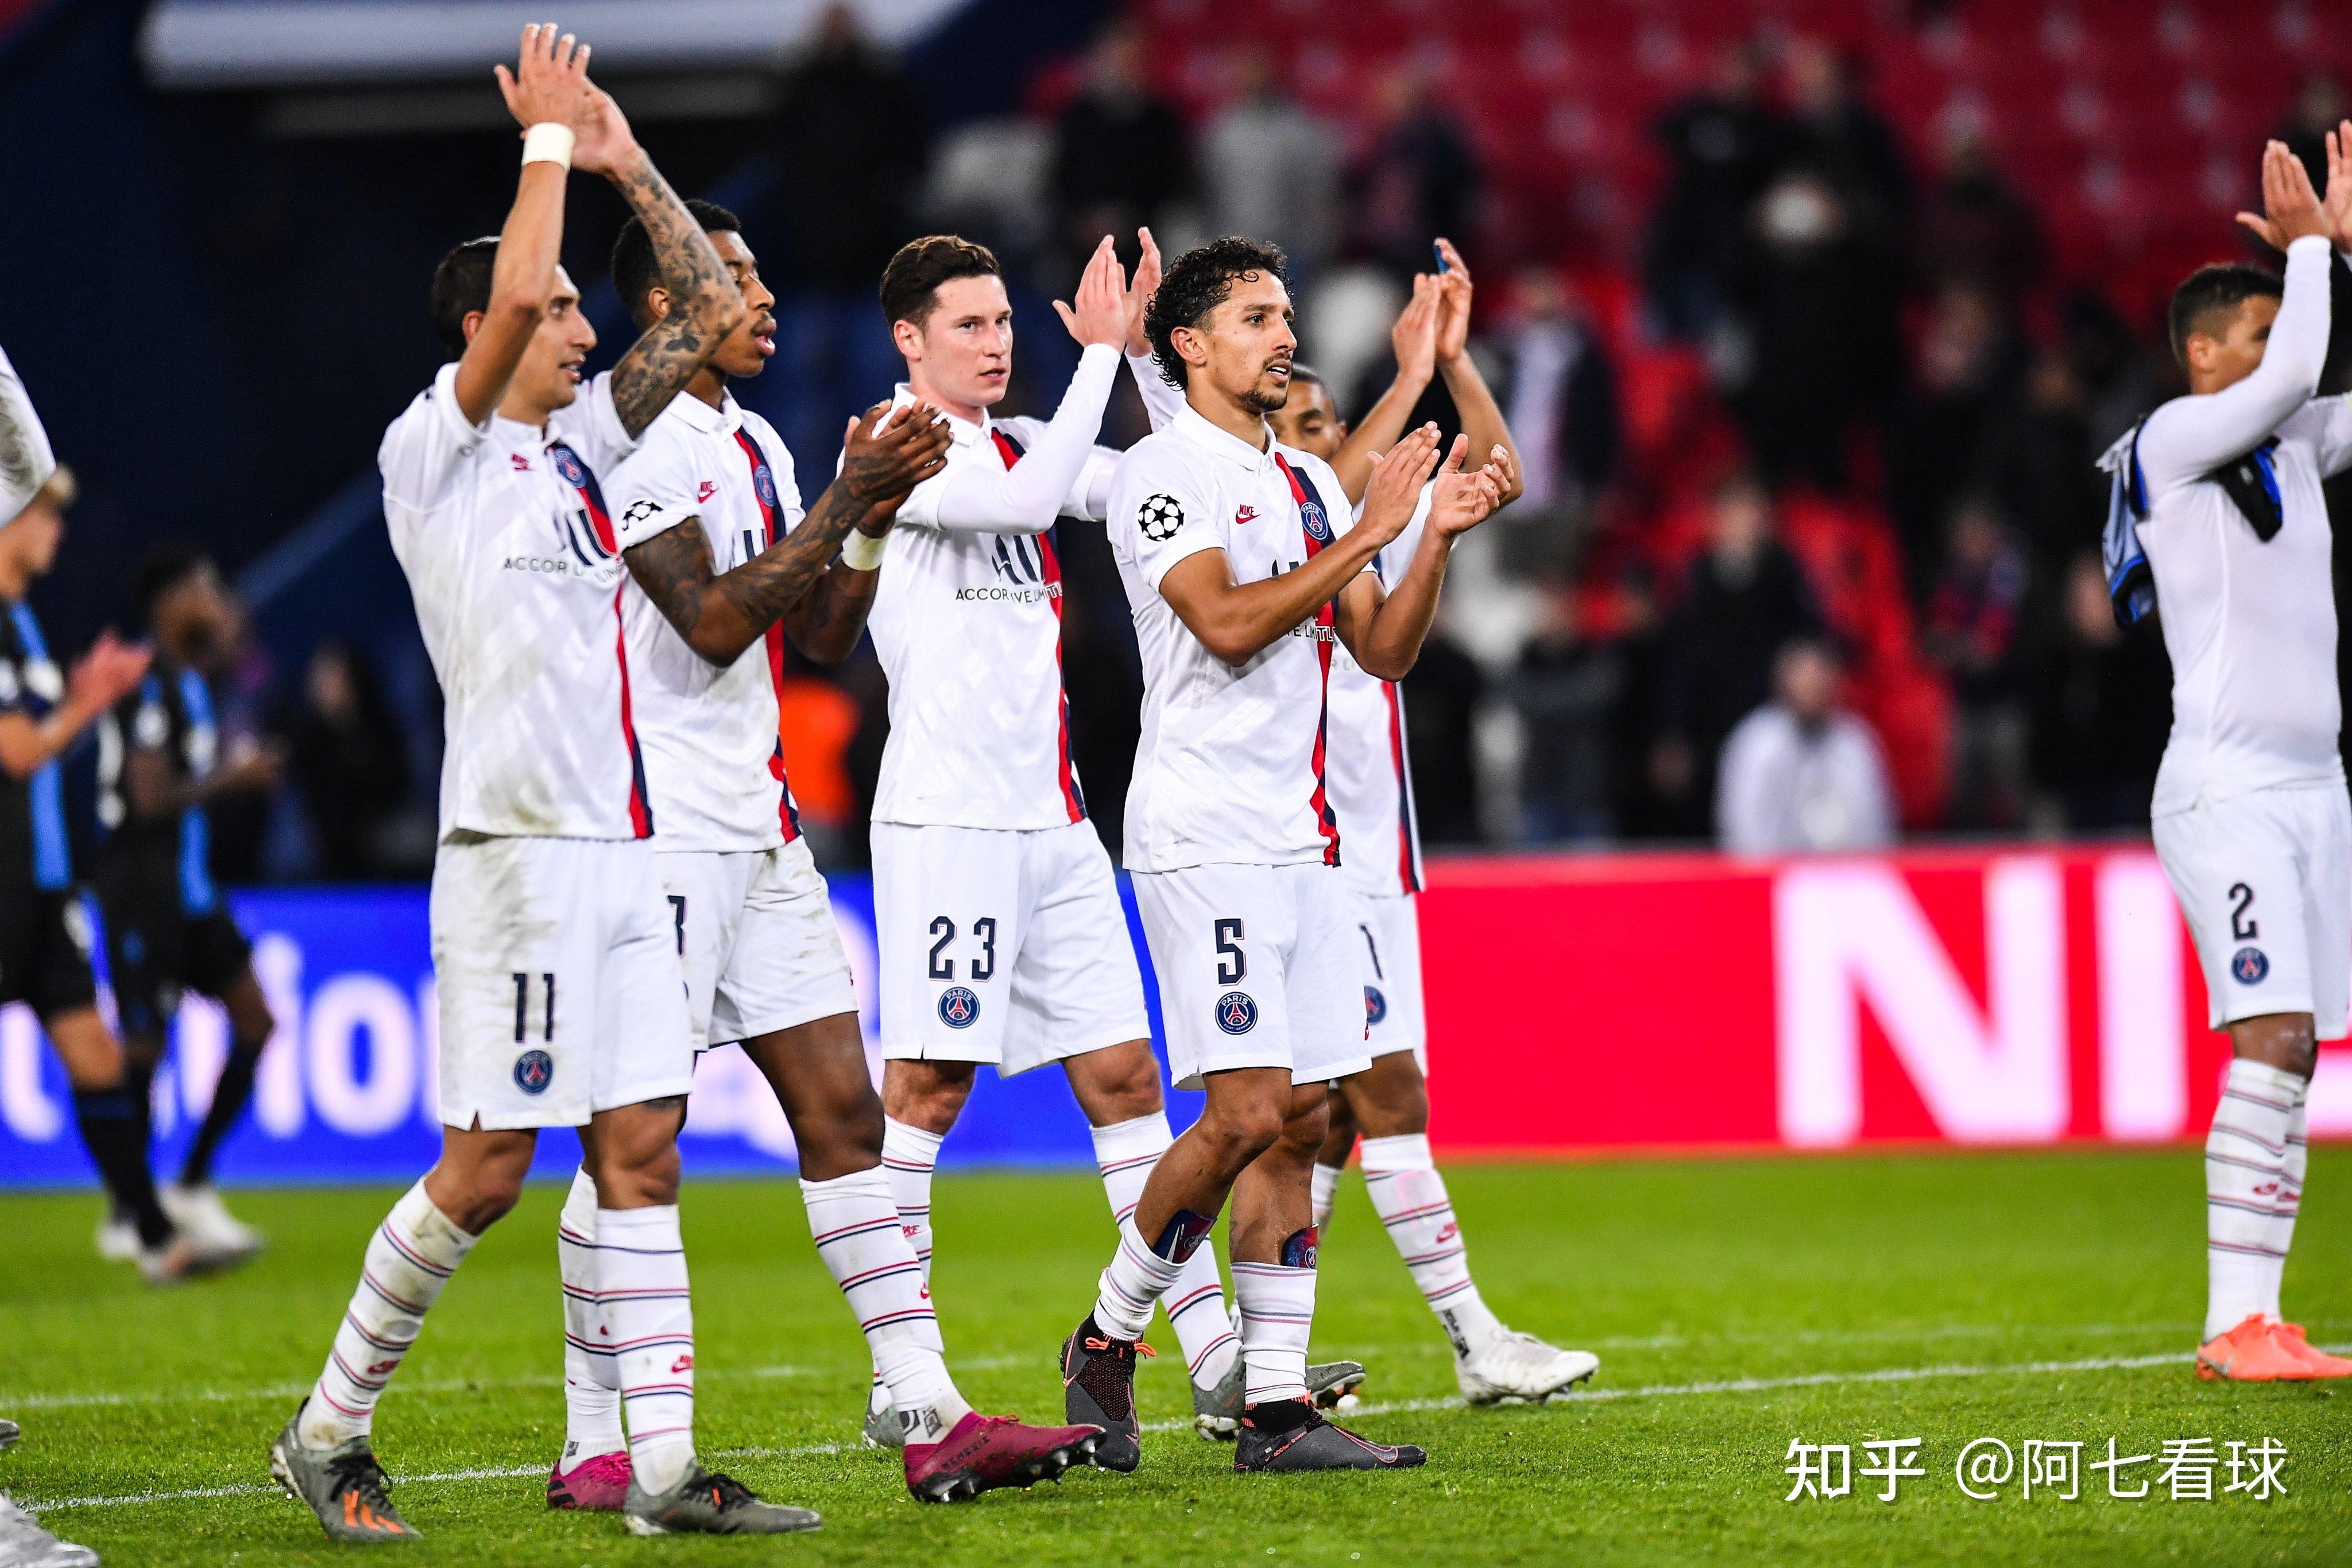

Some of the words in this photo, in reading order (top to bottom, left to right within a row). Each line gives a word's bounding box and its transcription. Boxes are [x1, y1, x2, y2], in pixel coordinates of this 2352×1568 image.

[1239, 504, 1255, 517] NIKE
[1302, 504, 1320, 514] PARIS
[503, 557, 567, 574] ACCOR
[956, 588, 1009, 601] ACCOR
[1011, 591, 1032, 603] IVE
[2228, 882, 2259, 942] 2
[928, 915, 997, 982] 23
[1214, 918, 1247, 987] 5
[946, 990, 972, 1001] PARIS
[1221, 995, 1248, 1006] PARIS
[1773, 860, 2187, 1143] NI
[513, 972, 555, 1043] 11
